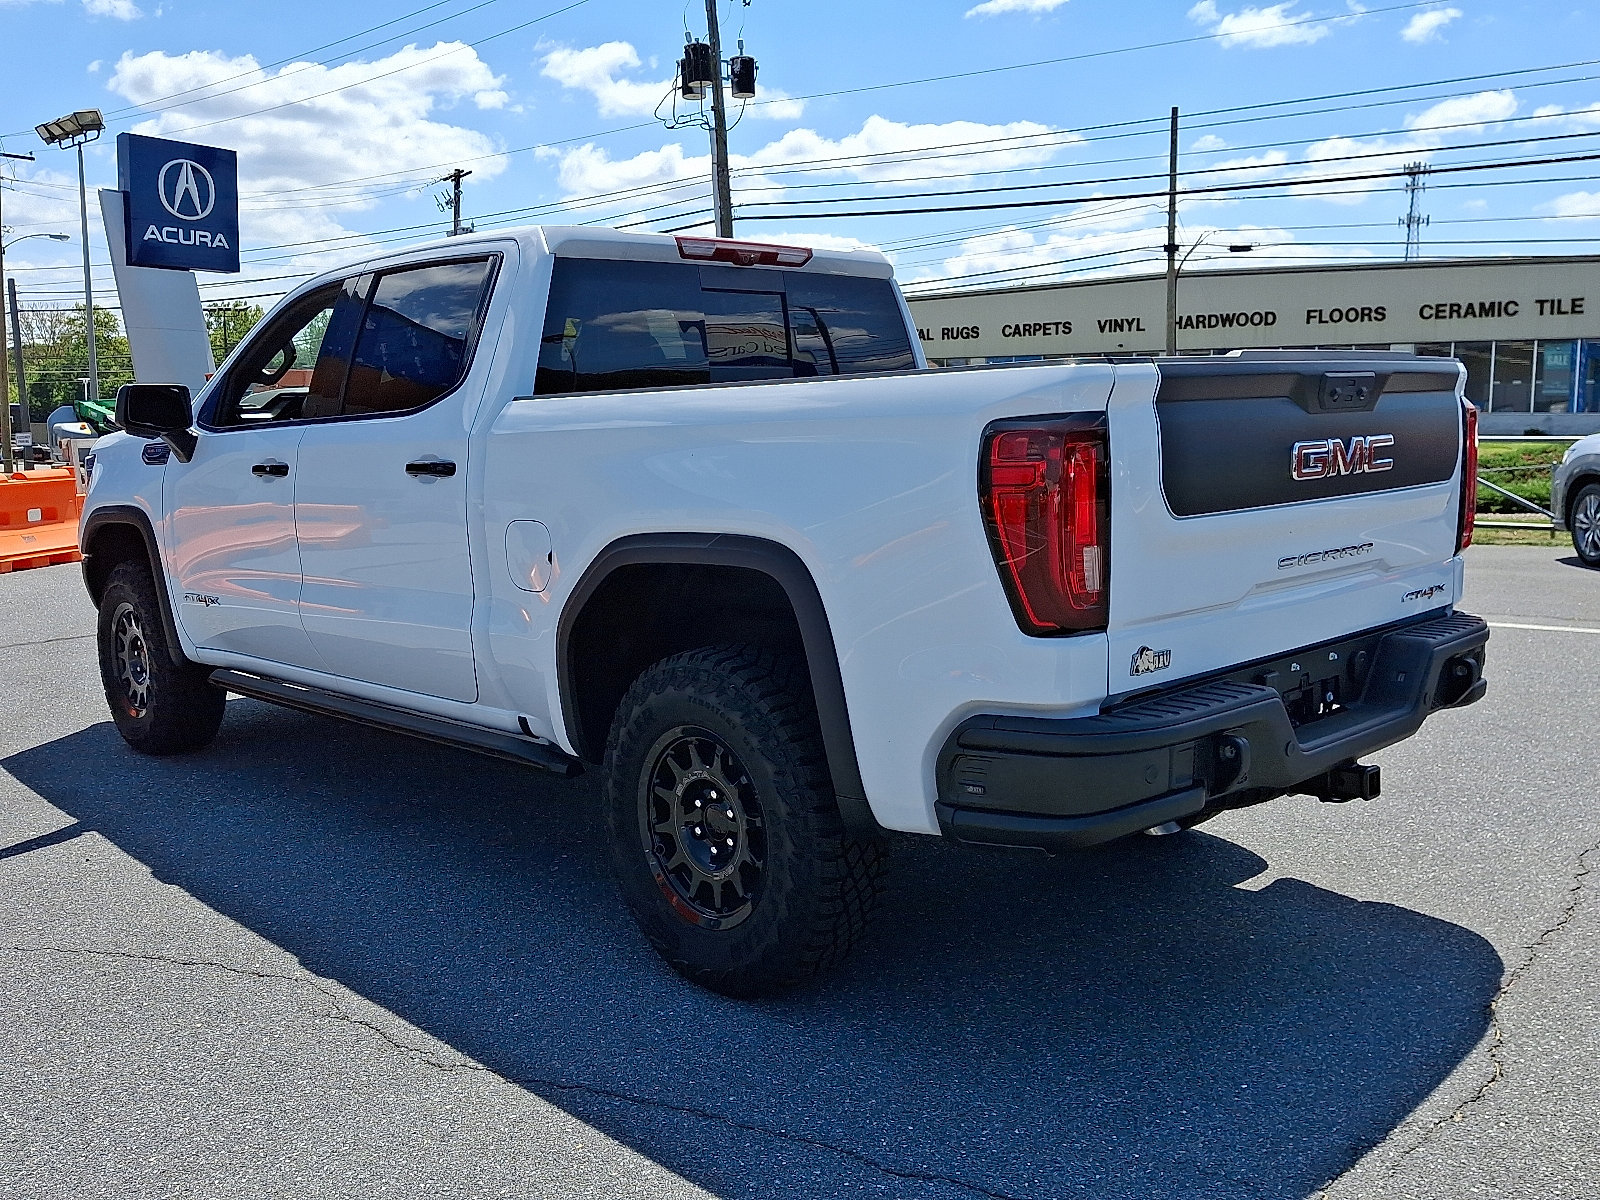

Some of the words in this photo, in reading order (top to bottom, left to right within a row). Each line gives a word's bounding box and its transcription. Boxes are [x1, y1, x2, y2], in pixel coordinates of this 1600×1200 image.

[143, 224, 230, 250] ACURA
[941, 326, 980, 341] RUGS
[1001, 321, 1073, 338] CARPETS
[1097, 317, 1146, 333] VINYL
[1175, 311, 1278, 330] HARDWOOD
[1305, 306, 1387, 325] FLOORS
[1418, 300, 1520, 320] CERAMIC
[1535, 297, 1586, 316] TILE
[1291, 434, 1395, 481] GMC
[1278, 542, 1374, 570] SIERRA
